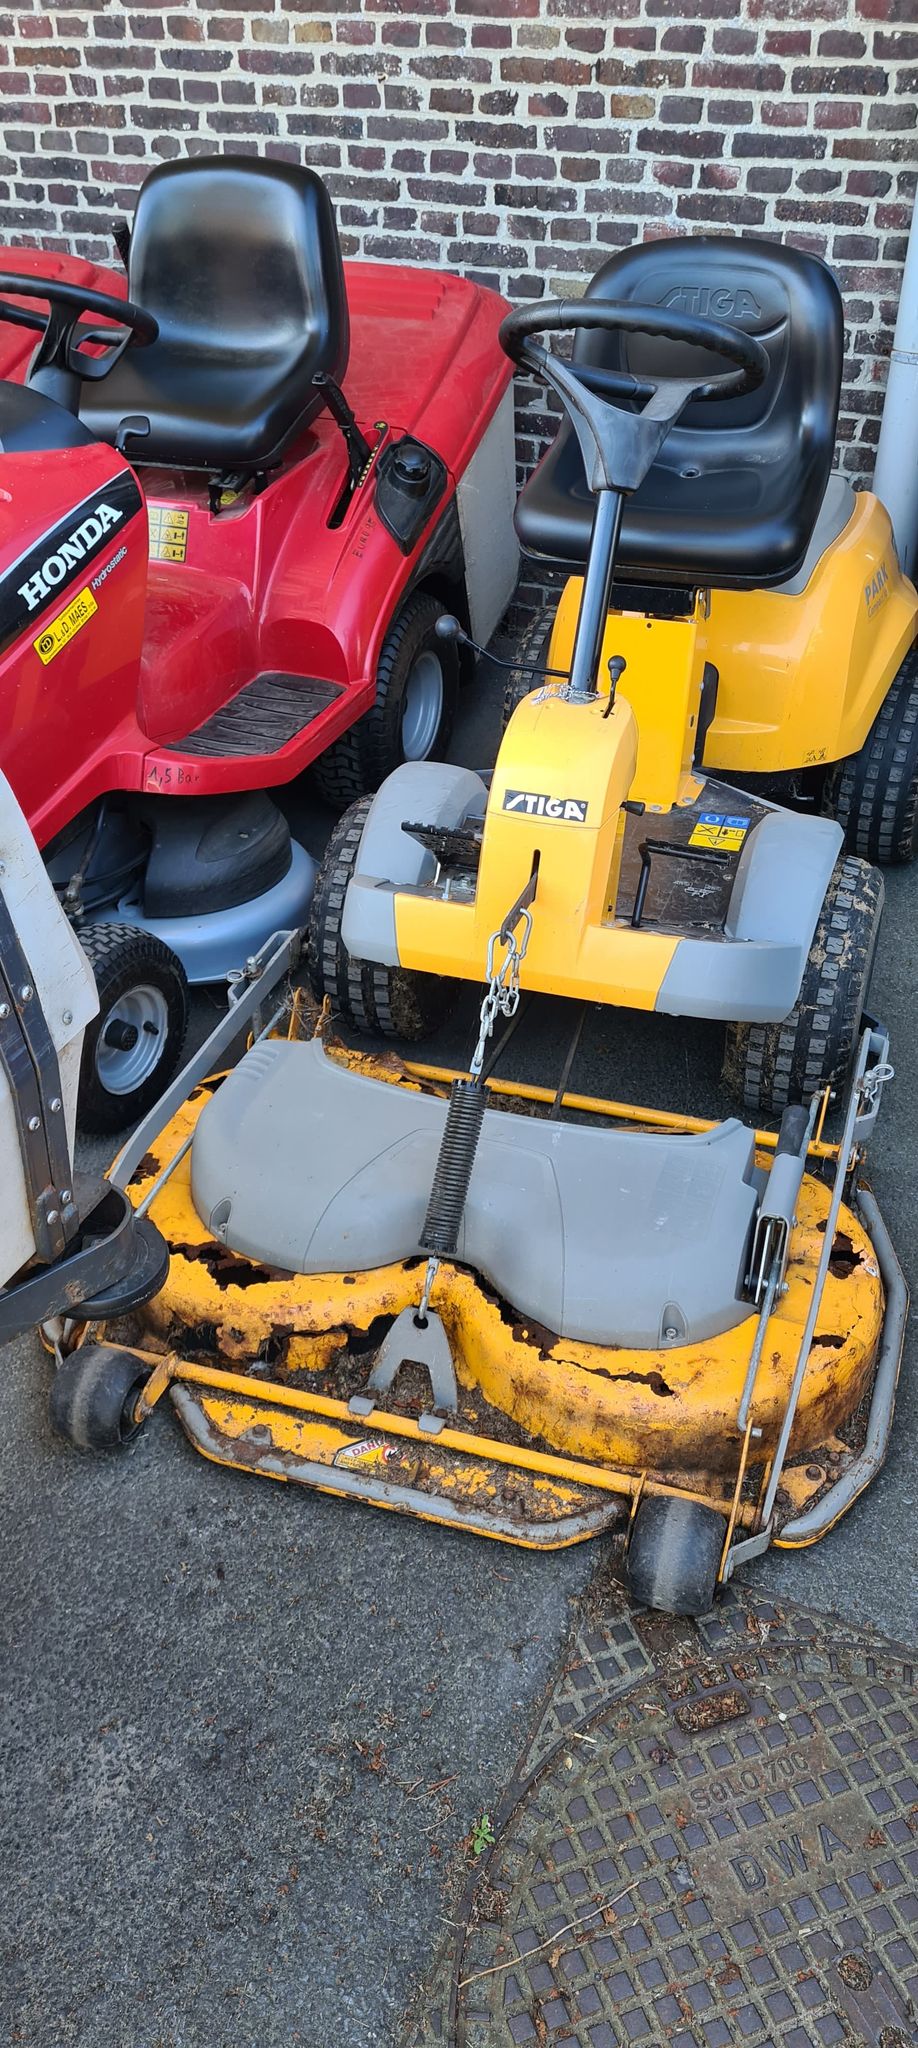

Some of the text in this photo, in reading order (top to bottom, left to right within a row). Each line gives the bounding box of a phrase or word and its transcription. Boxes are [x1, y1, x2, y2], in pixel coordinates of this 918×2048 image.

[656, 287, 761, 318] STIGA
[17, 503, 123, 611] HONDA
[92, 546, 127, 590] Hydrostatic
[864, 563, 888, 607] PARK
[68, 601, 88, 626] MAES
[148, 766, 200, 787] 1,5 Bar
[505, 793, 585, 821] STIGA
[690, 1769, 760, 1811] SOLO
